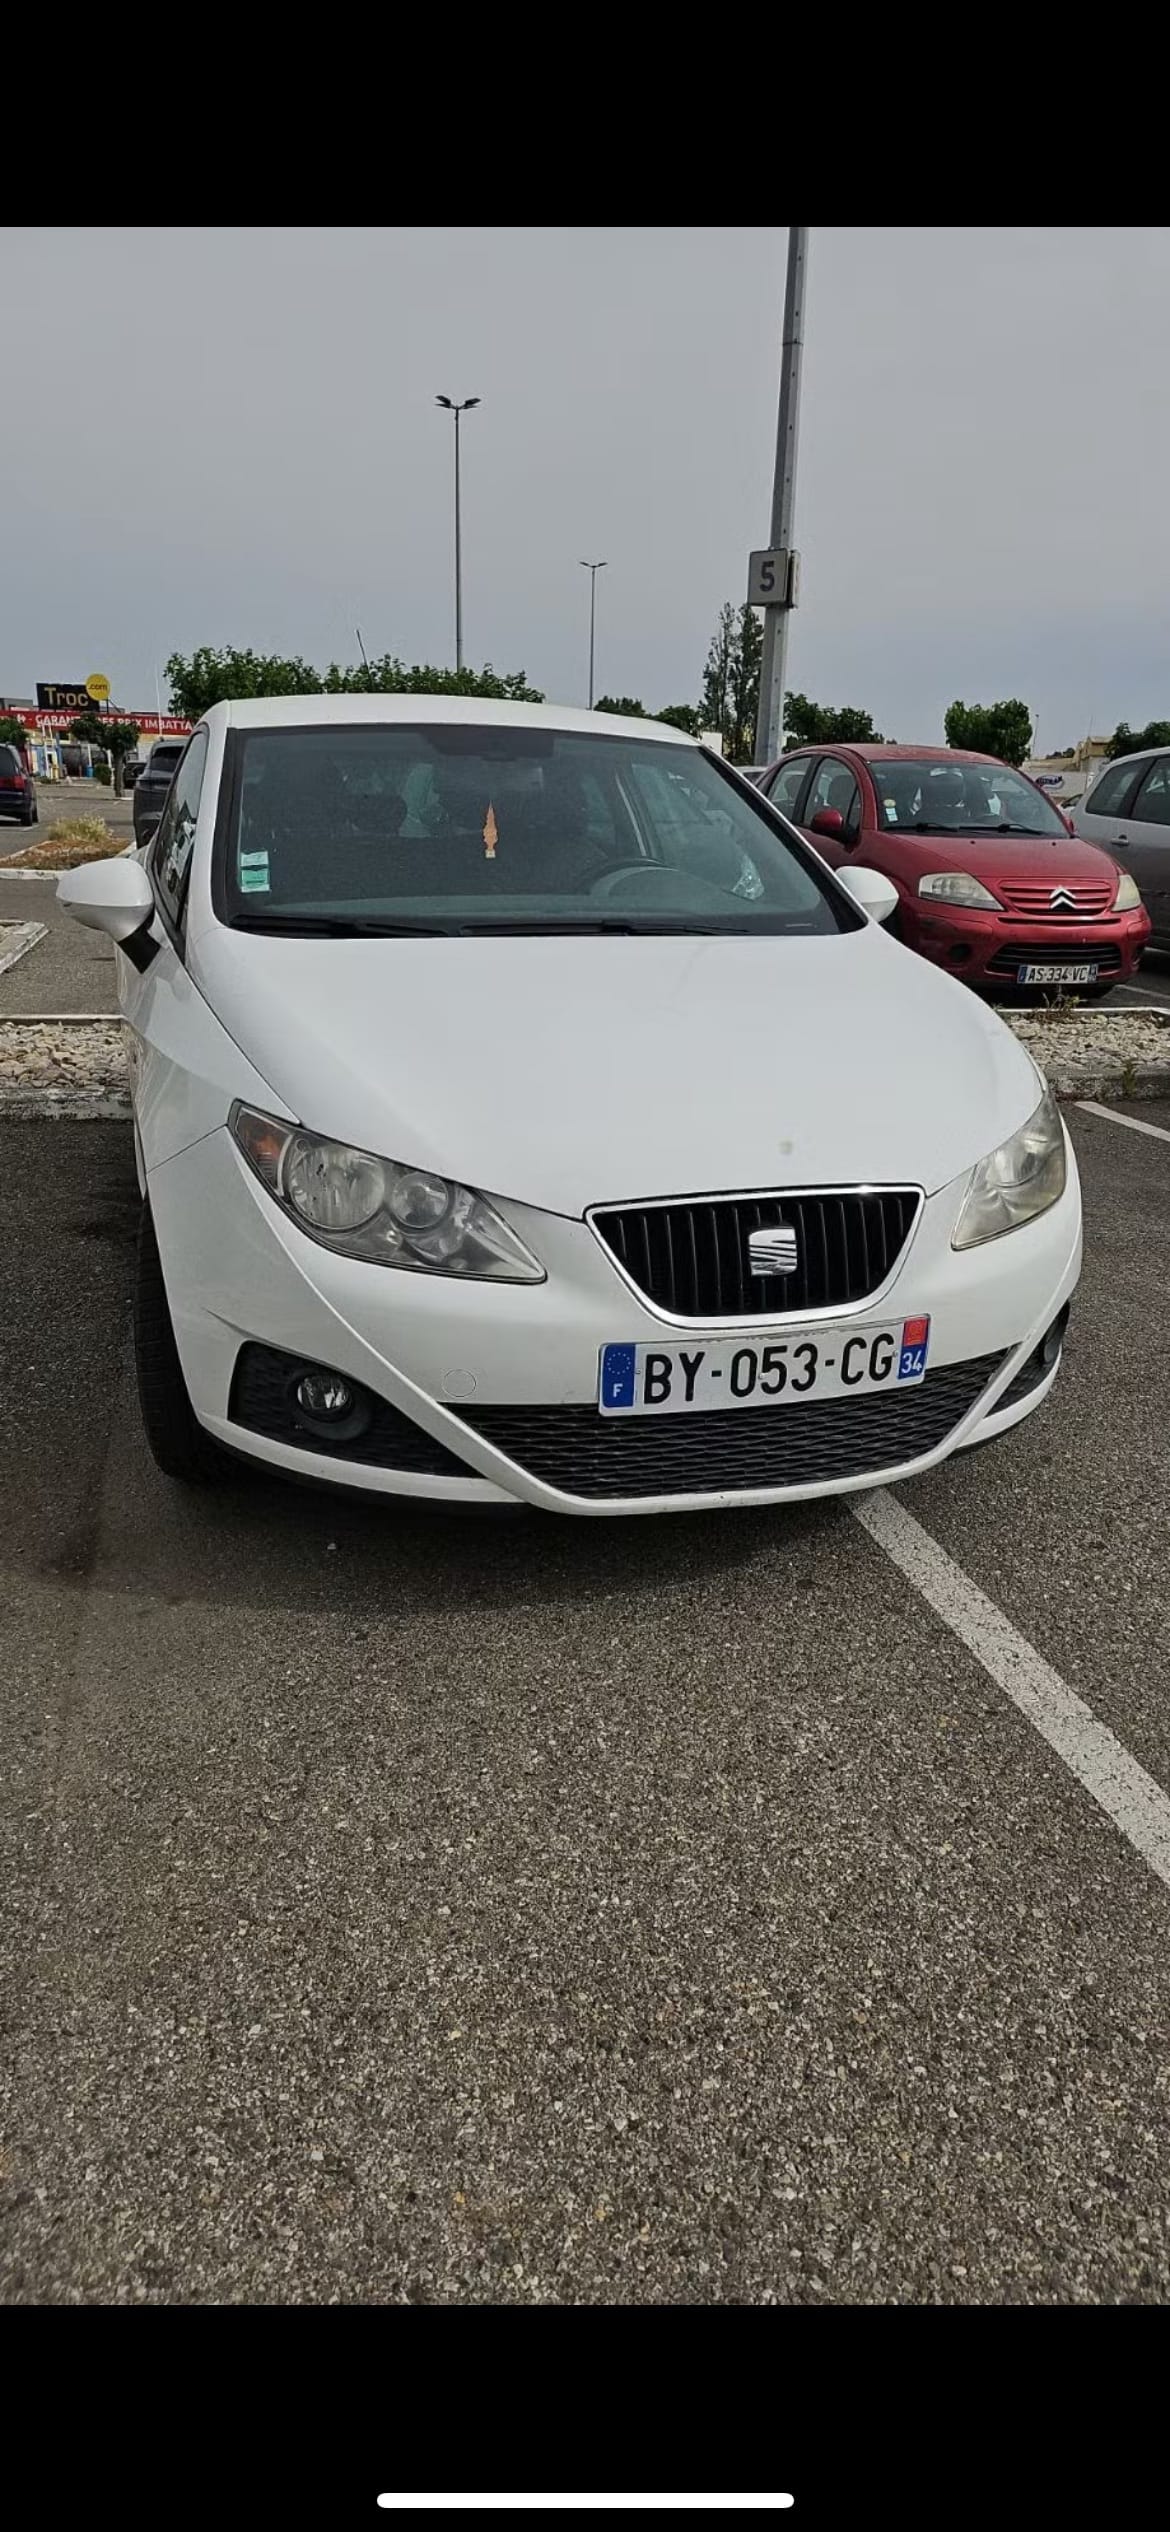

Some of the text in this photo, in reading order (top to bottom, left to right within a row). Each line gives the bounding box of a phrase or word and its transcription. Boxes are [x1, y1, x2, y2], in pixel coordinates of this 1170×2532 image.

[760, 560, 775, 592] 5
[44, 686, 89, 706] Troc
[117, 717, 142, 727] PRX
[613, 1332, 922, 1405] F BY-053-CG 34
